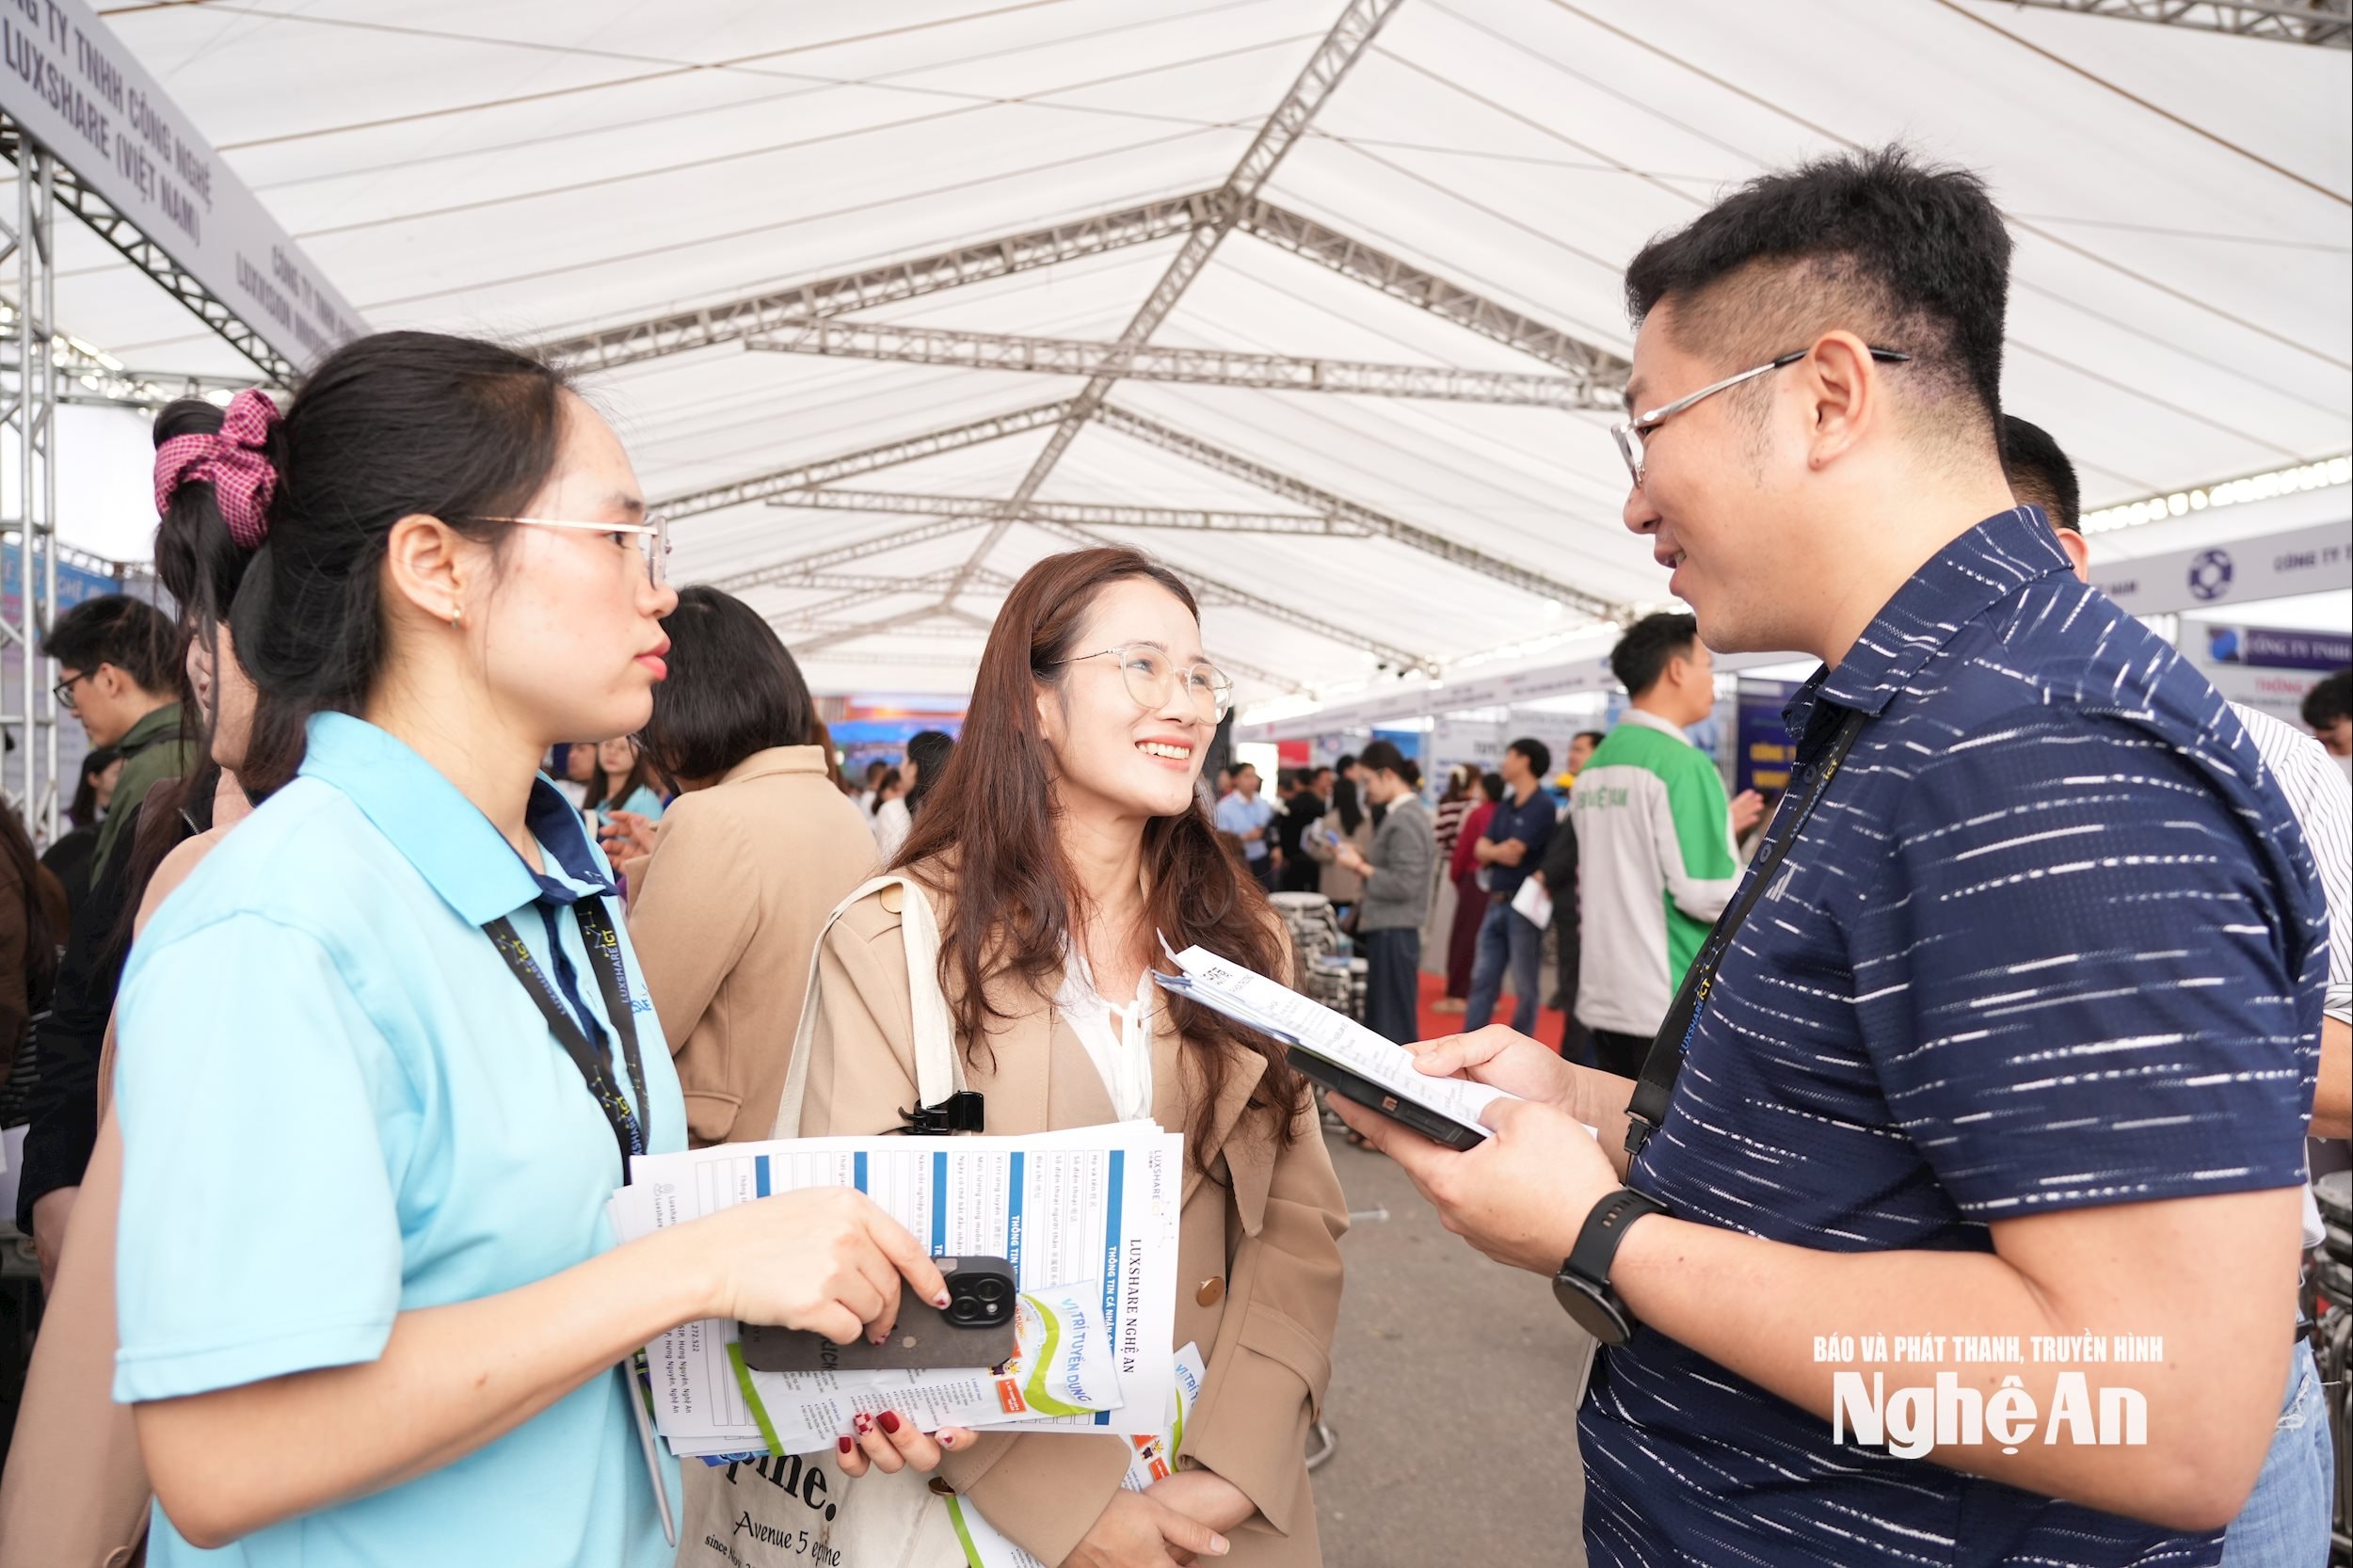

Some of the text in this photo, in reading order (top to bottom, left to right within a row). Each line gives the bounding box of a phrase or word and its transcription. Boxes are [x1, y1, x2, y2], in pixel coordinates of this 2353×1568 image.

[48, 0, 68, 56] TY
[75, 26, 123, 114] TNHH
[129, 86, 171, 164] CÔNG
[176, 136, 213, 214] NGHỆ
[3, 16, 201, 247] LUXSHARE (VIỆT NAM)
[610, 947, 631, 1003] LUXSHARE
[1679, 1000, 1704, 1054] LUXSHARE
[1151, 1150, 1162, 1200] LUXSHARE
[1011, 1215, 1022, 1246] THÔNG
[1010, 1248, 1019, 1264] TIN
[1107, 1246, 1118, 1277] THÔNG
[1106, 1279, 1116, 1294] TIN
[1106, 1296, 1116, 1308] CÁ
[1120, 1239, 1142, 1373] LUXSHARE NGHỆ AN
[1072, 1312, 1090, 1332] TRÍ
[1067, 1333, 1086, 1373] TUYỂN
[665, 1361, 676, 1386] Nguyên,
[679, 1362, 689, 1386] Nguyên,
[1185, 1373, 1199, 1393] TRÍ
[669, 1388, 679, 1403] Nghệ
[682, 1388, 691, 1403] Nghệ
[1064, 1375, 1093, 1401] DỤNG
[672, 1405, 680, 1414] An
[685, 1405, 692, 1414] An
[705, 1535, 728, 1556] since
[733, 1511, 841, 1567] Avenue 5 epine
